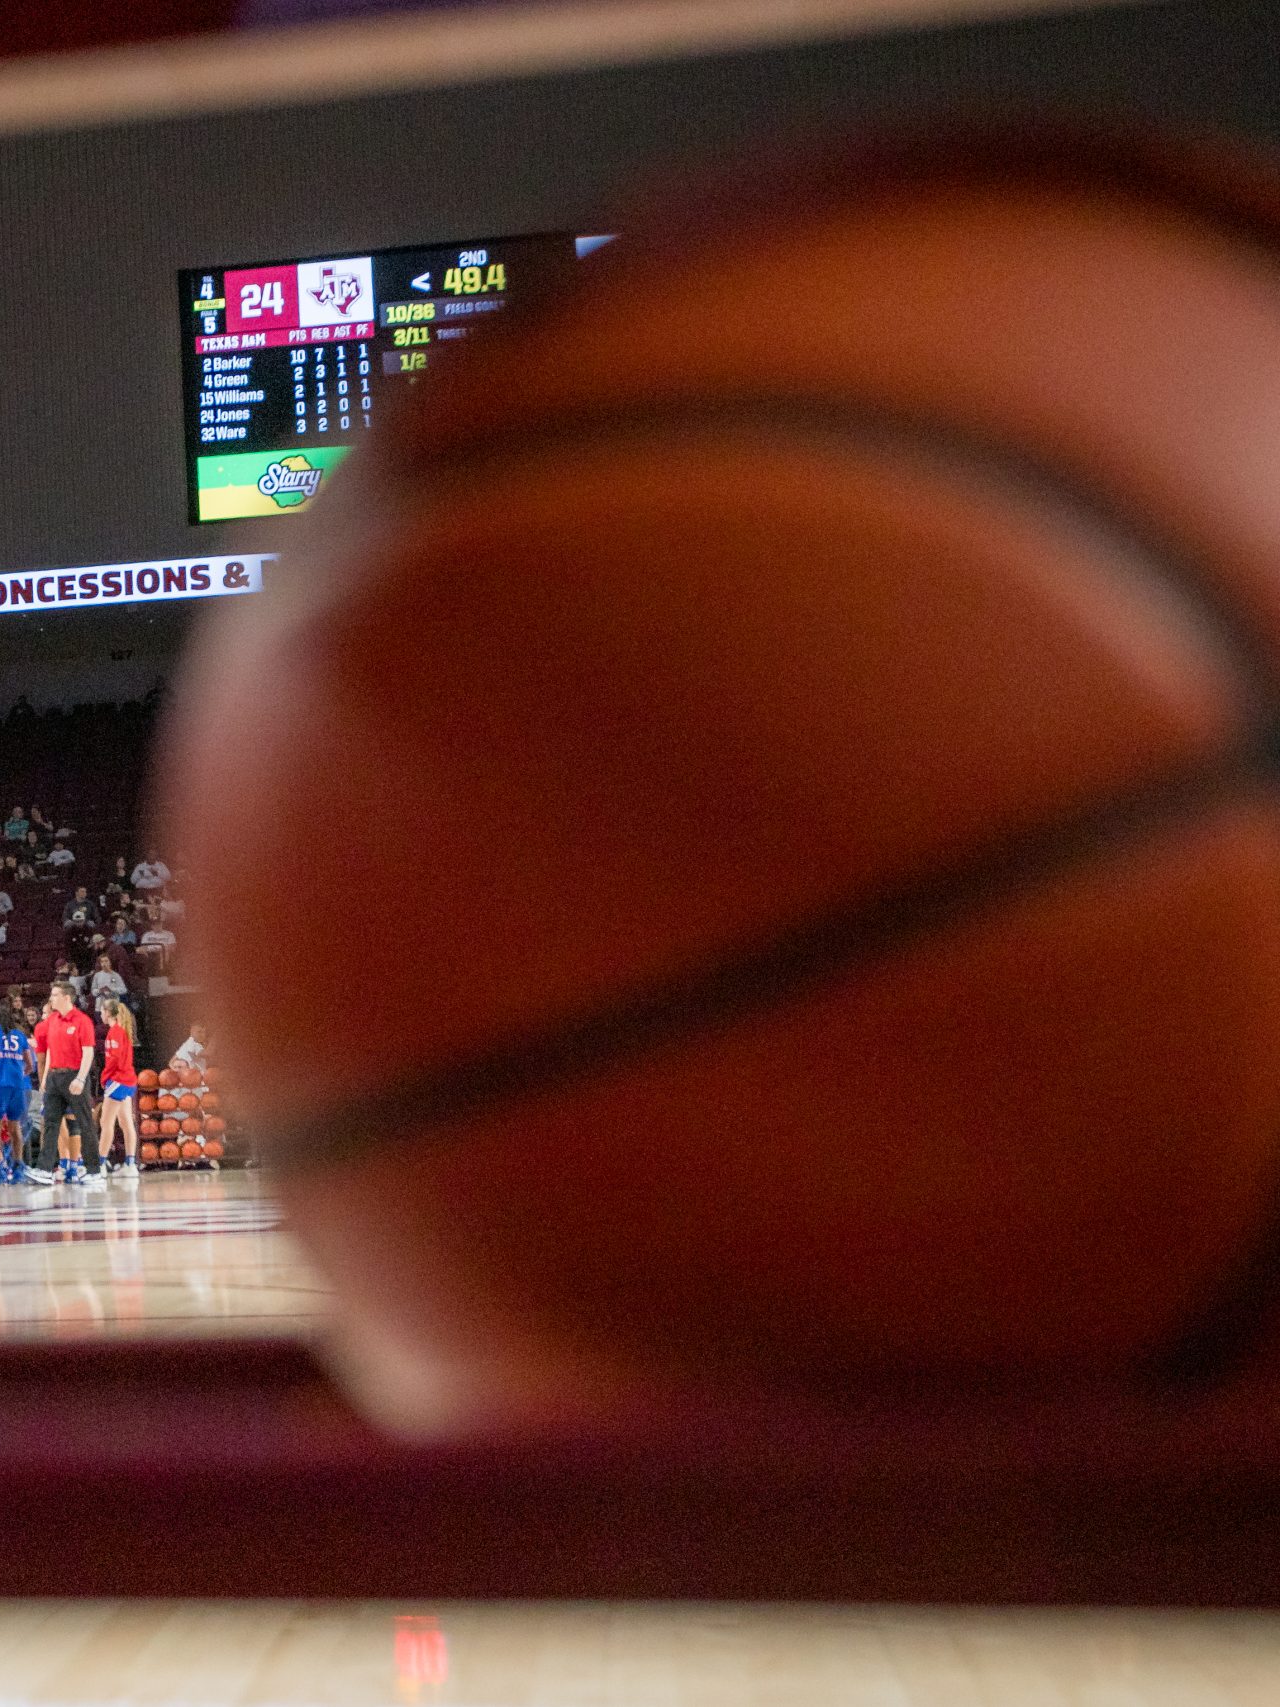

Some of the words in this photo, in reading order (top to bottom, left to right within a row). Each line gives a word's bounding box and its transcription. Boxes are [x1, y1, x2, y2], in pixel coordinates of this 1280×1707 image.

[459, 250, 487, 267] 2ND
[201, 282, 213, 299] 4
[444, 264, 506, 295] 49.4
[240, 282, 284, 318] 24
[386, 303, 435, 323] 10/36
[201, 336, 239, 351] TEXAS
[241, 333, 266, 347] A&M
[289, 330, 306, 342] PTS
[311, 327, 329, 340] REB
[334, 325, 351, 338] AST
[356, 323, 368, 335] PF
[204, 317, 216, 334] 5
[394, 327, 430, 346] 3/11
[203, 358, 212, 372] 2
[213, 356, 252, 371] Barker
[290, 350, 306, 364] 10
[314, 348, 324, 362] 7
[337, 346, 346, 360] 1
[359, 344, 368, 358] 1
[400, 352, 427, 371] 1/2
[203, 374, 213, 388] 4
[214, 374, 248, 388] Green
[294, 366, 304, 380] 2
[315, 364, 325, 378] 3
[337, 362, 346, 377] 1
[359, 360, 369, 375] 0
[200, 392, 213, 407] 15
[213, 390, 264, 405] Williams
[294, 384, 304, 399] 2
[317, 382, 325, 396] 1
[338, 380, 348, 394] 0
[361, 379, 369, 393] 1
[200, 409, 215, 423] 24
[215, 409, 250, 423] Jones
[296, 401, 305, 416] 0
[317, 399, 327, 414] 2
[339, 397, 349, 411] 0
[362, 396, 371, 410] 0
[201, 427, 215, 442] 32
[215, 426, 246, 440] Ware
[297, 419, 306, 434] 3
[319, 417, 328, 432] 2
[341, 415, 350, 430] 0
[363, 414, 371, 428] 1
[258, 463, 323, 496] Starry
[222, 562, 249, 588] &
[2, 1034, 19, 1051] 15
